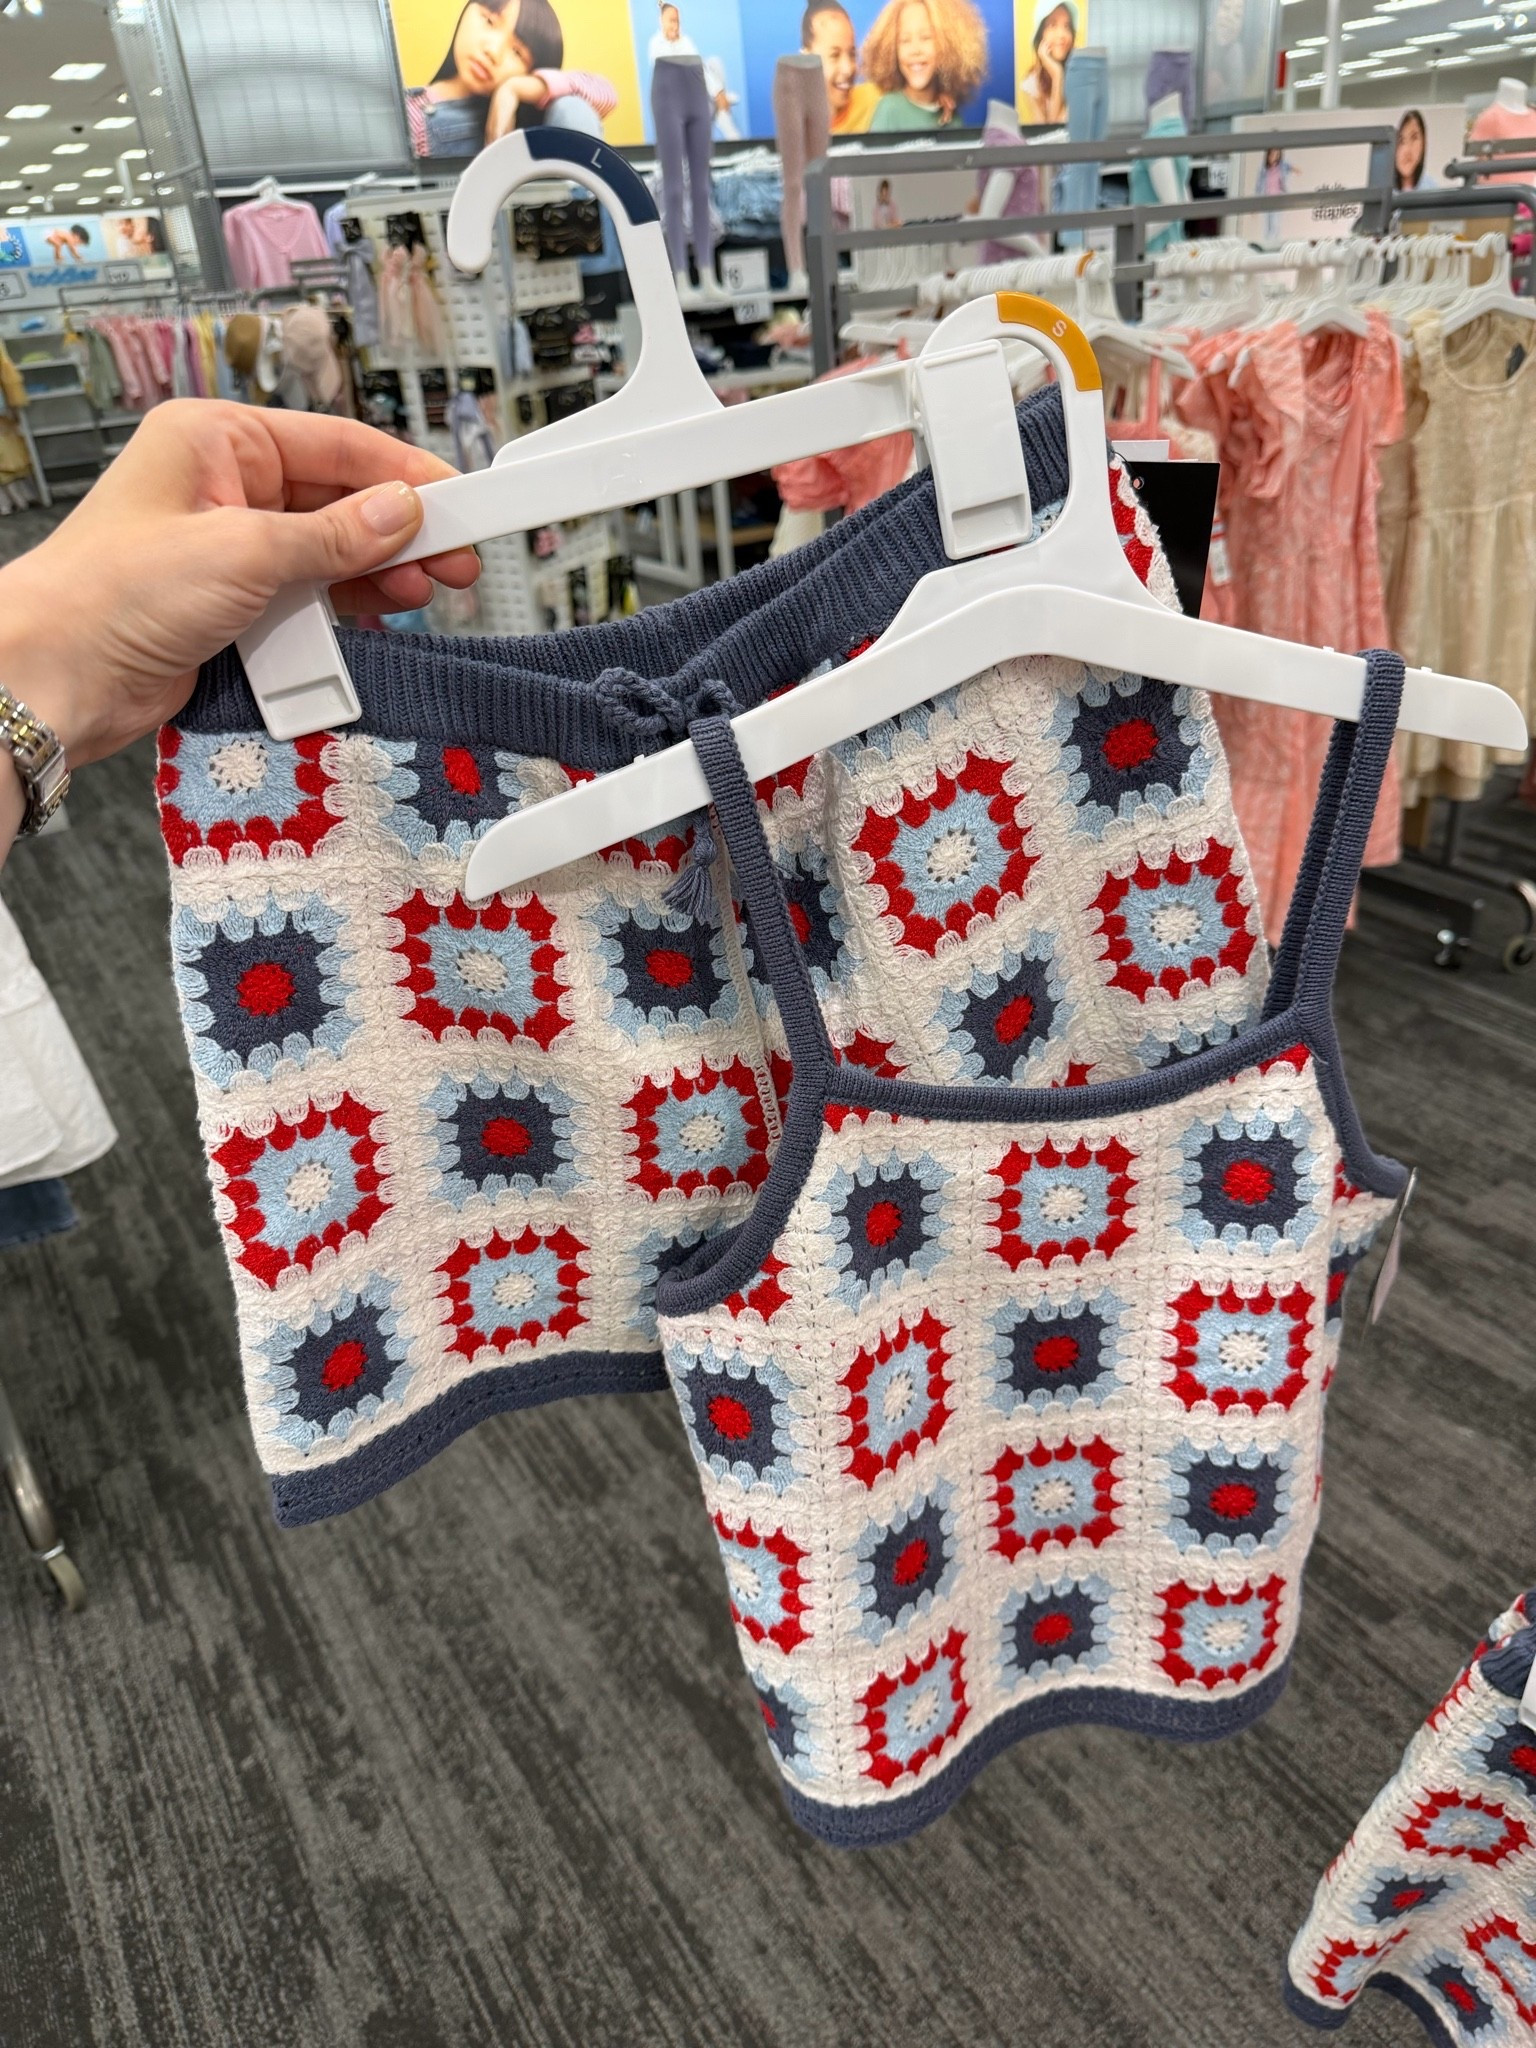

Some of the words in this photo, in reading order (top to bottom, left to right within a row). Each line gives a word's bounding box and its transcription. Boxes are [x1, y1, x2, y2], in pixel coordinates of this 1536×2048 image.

[591, 148, 602, 169] L
[27, 266, 98, 288] toddler
[1052, 319, 1067, 338] S
